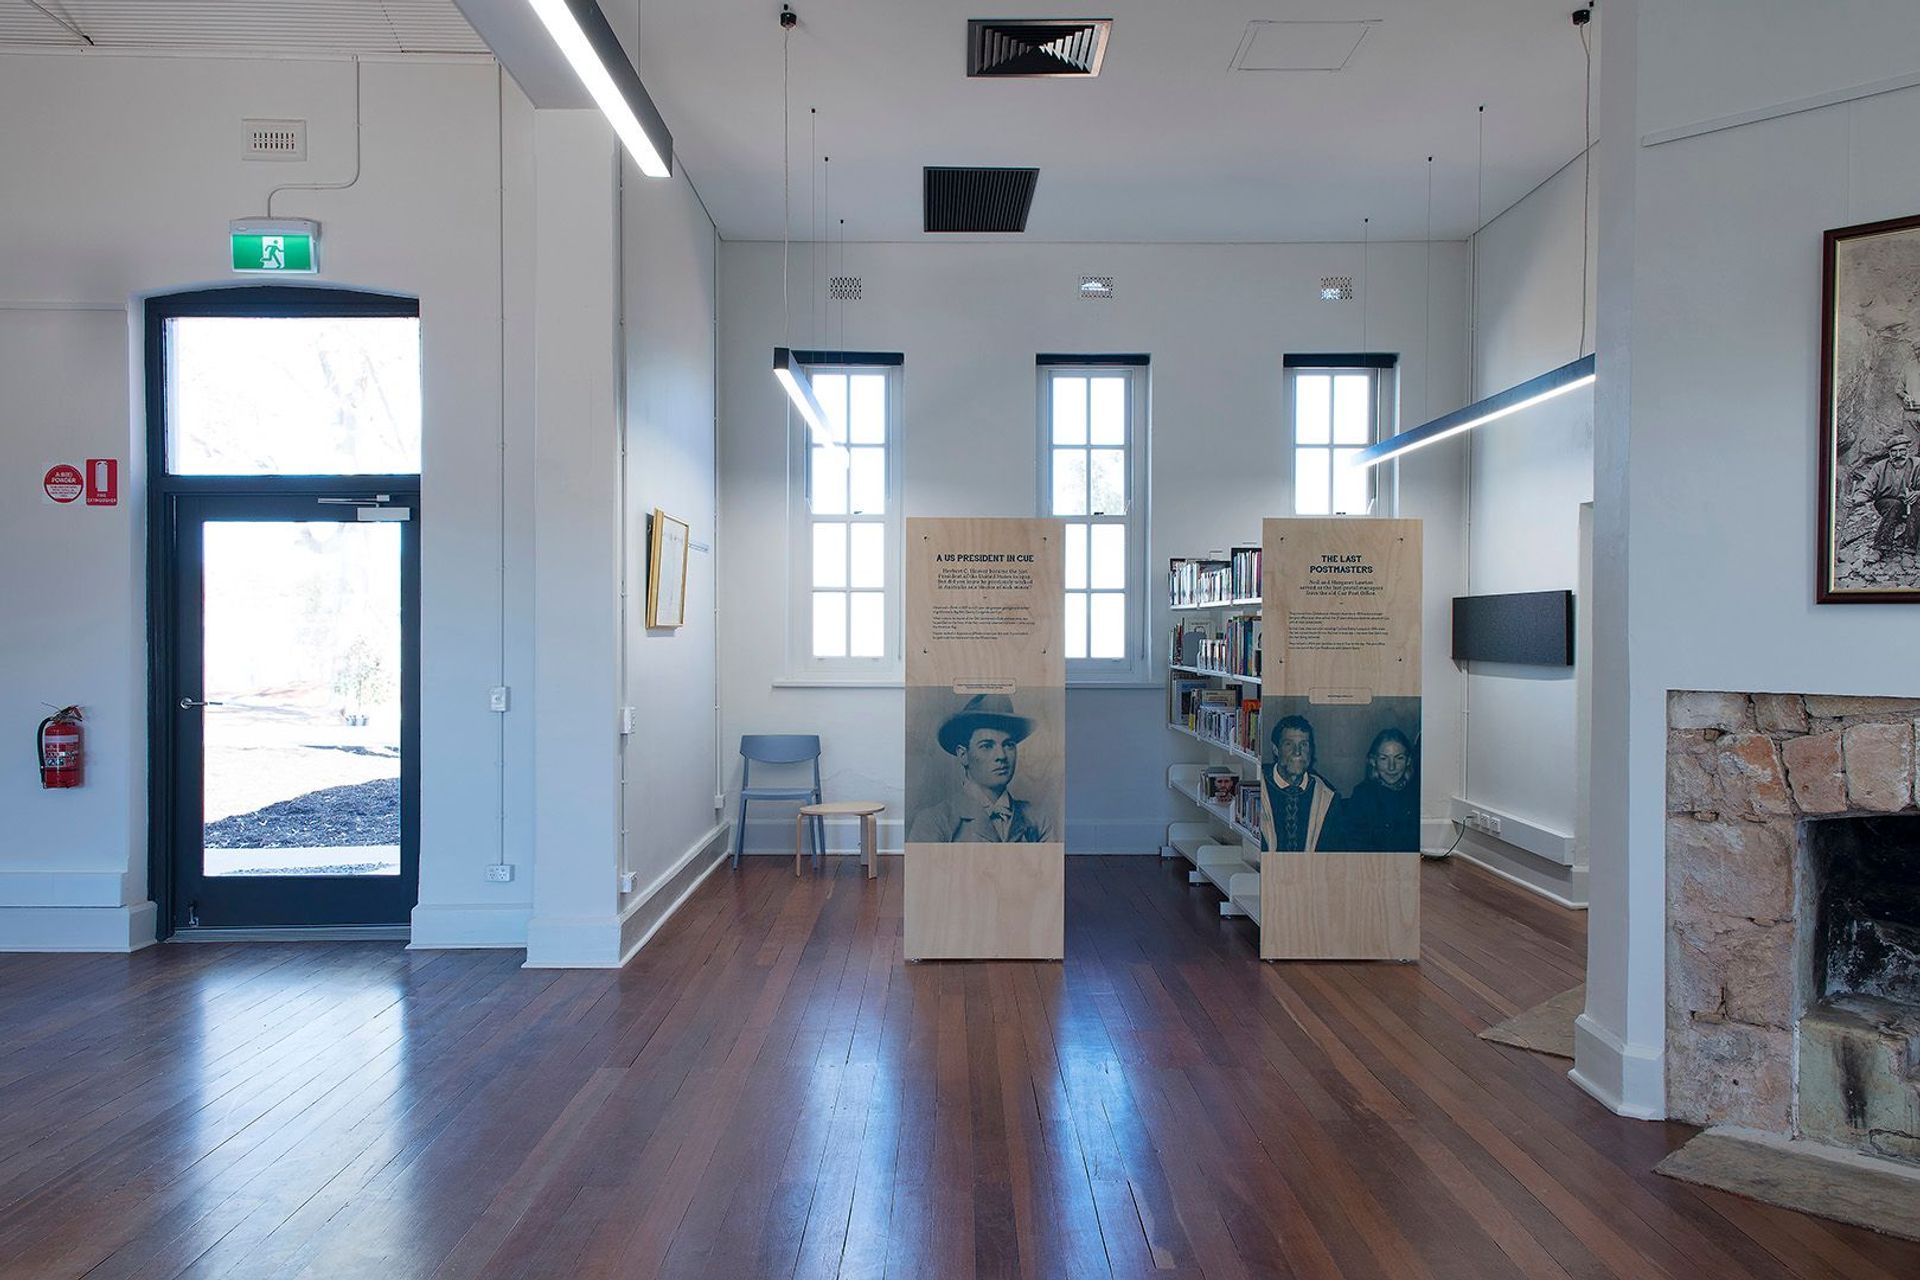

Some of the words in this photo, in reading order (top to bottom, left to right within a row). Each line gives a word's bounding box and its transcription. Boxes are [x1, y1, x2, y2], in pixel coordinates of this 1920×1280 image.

[937, 554, 942, 562] A
[944, 554, 956, 562] US
[958, 554, 1004, 562] PRESIDENT
[1006, 554, 1015, 562] IN
[1016, 554, 1034, 562] CUE
